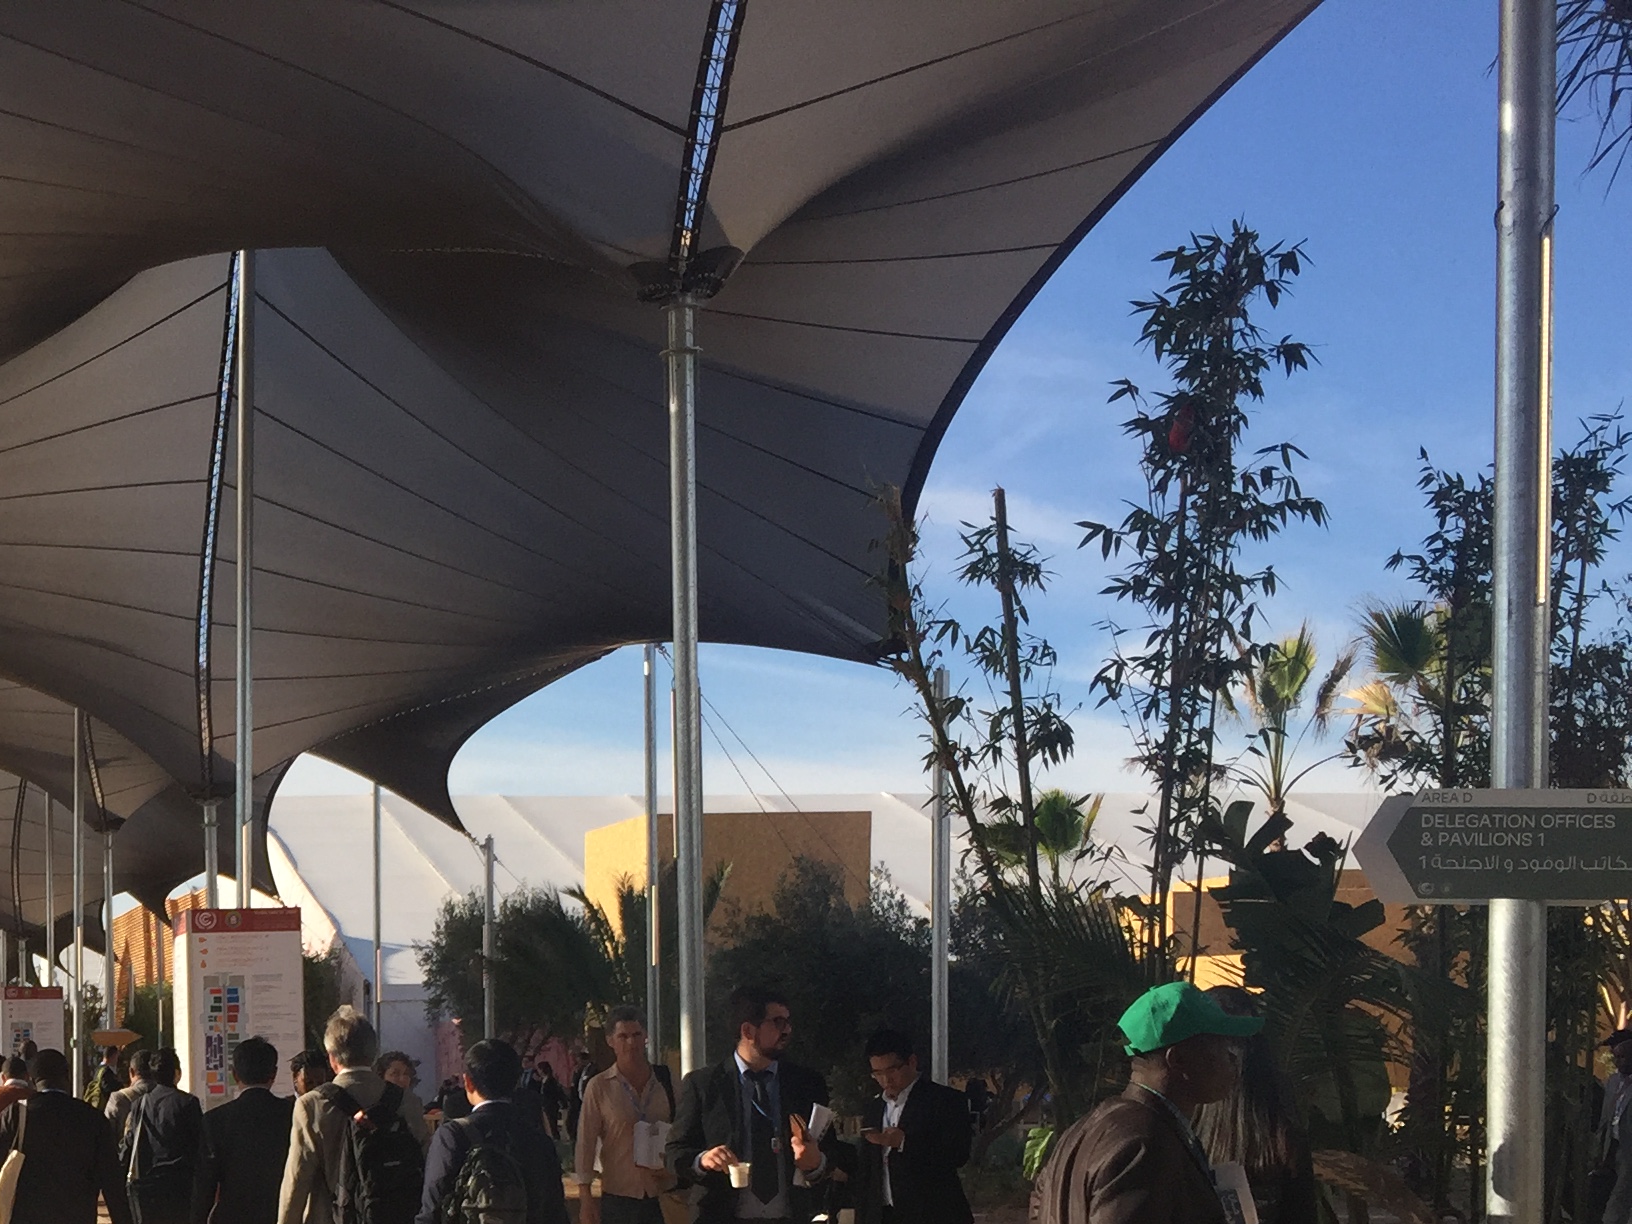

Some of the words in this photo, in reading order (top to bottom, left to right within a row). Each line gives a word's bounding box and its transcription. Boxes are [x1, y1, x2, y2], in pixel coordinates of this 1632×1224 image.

[1421, 792, 1459, 804] AREA
[1463, 792, 1473, 803] D
[1587, 792, 1597, 804] D
[1421, 814, 1535, 829] DELEGATION
[1541, 814, 1616, 829] OFFICES
[1420, 832, 1433, 847] &
[1438, 832, 1532, 847] PAVILIONS
[1538, 832, 1545, 847] 1
[1419, 855, 1427, 870] 1
[1504, 858, 1514, 873] و
